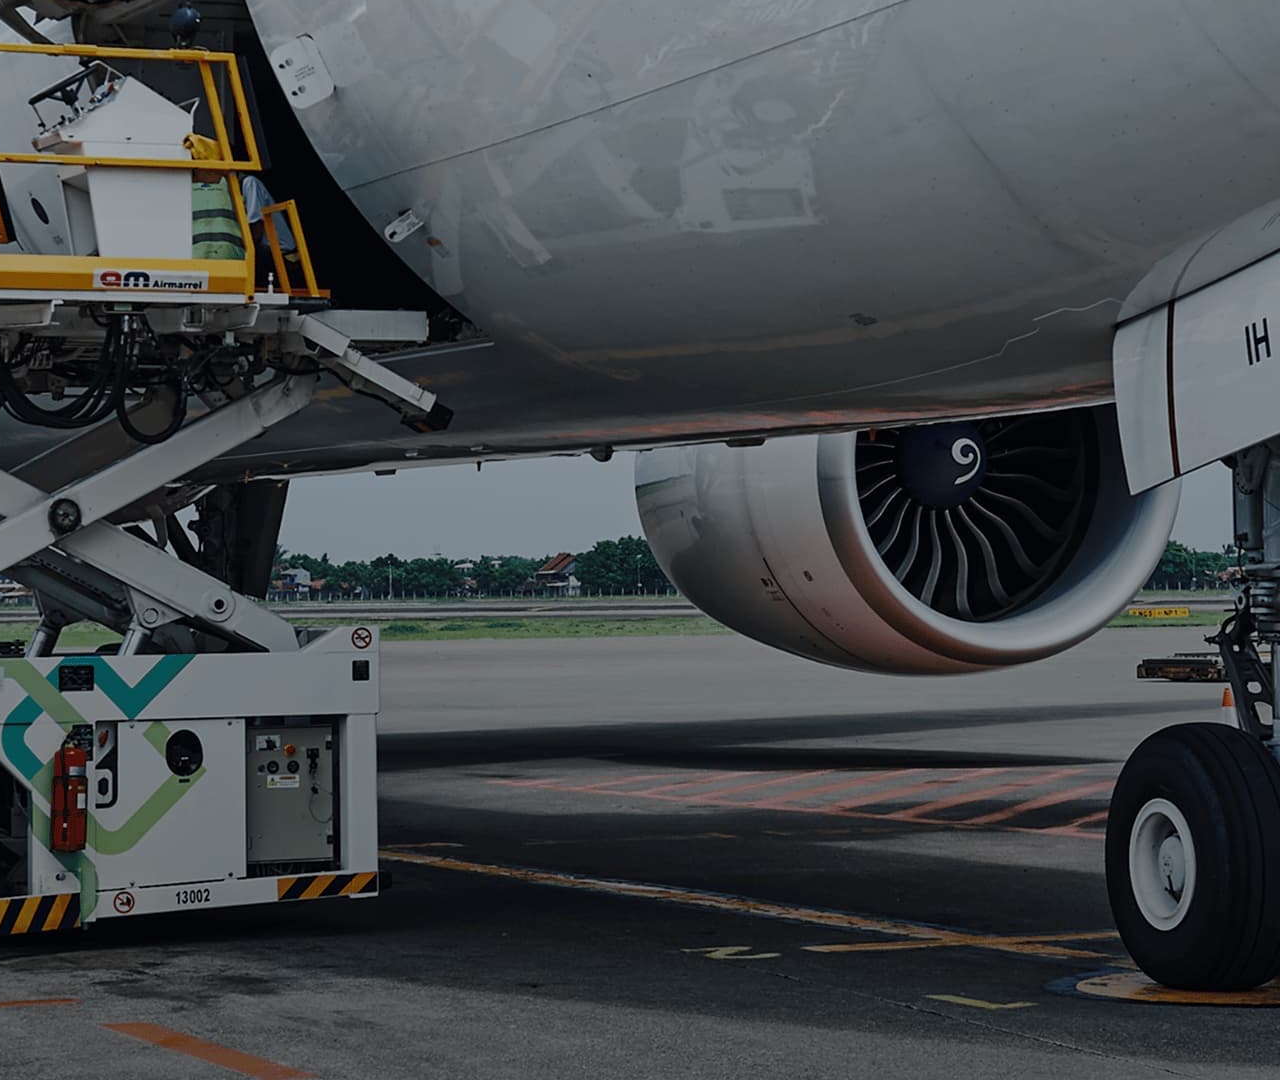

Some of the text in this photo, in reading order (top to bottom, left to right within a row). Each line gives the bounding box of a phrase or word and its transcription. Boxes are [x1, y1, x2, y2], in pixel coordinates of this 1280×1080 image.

[152, 280, 202, 289] Airmarrel
[1245, 318, 1271, 365] IH
[176, 888, 211, 905] 13002
